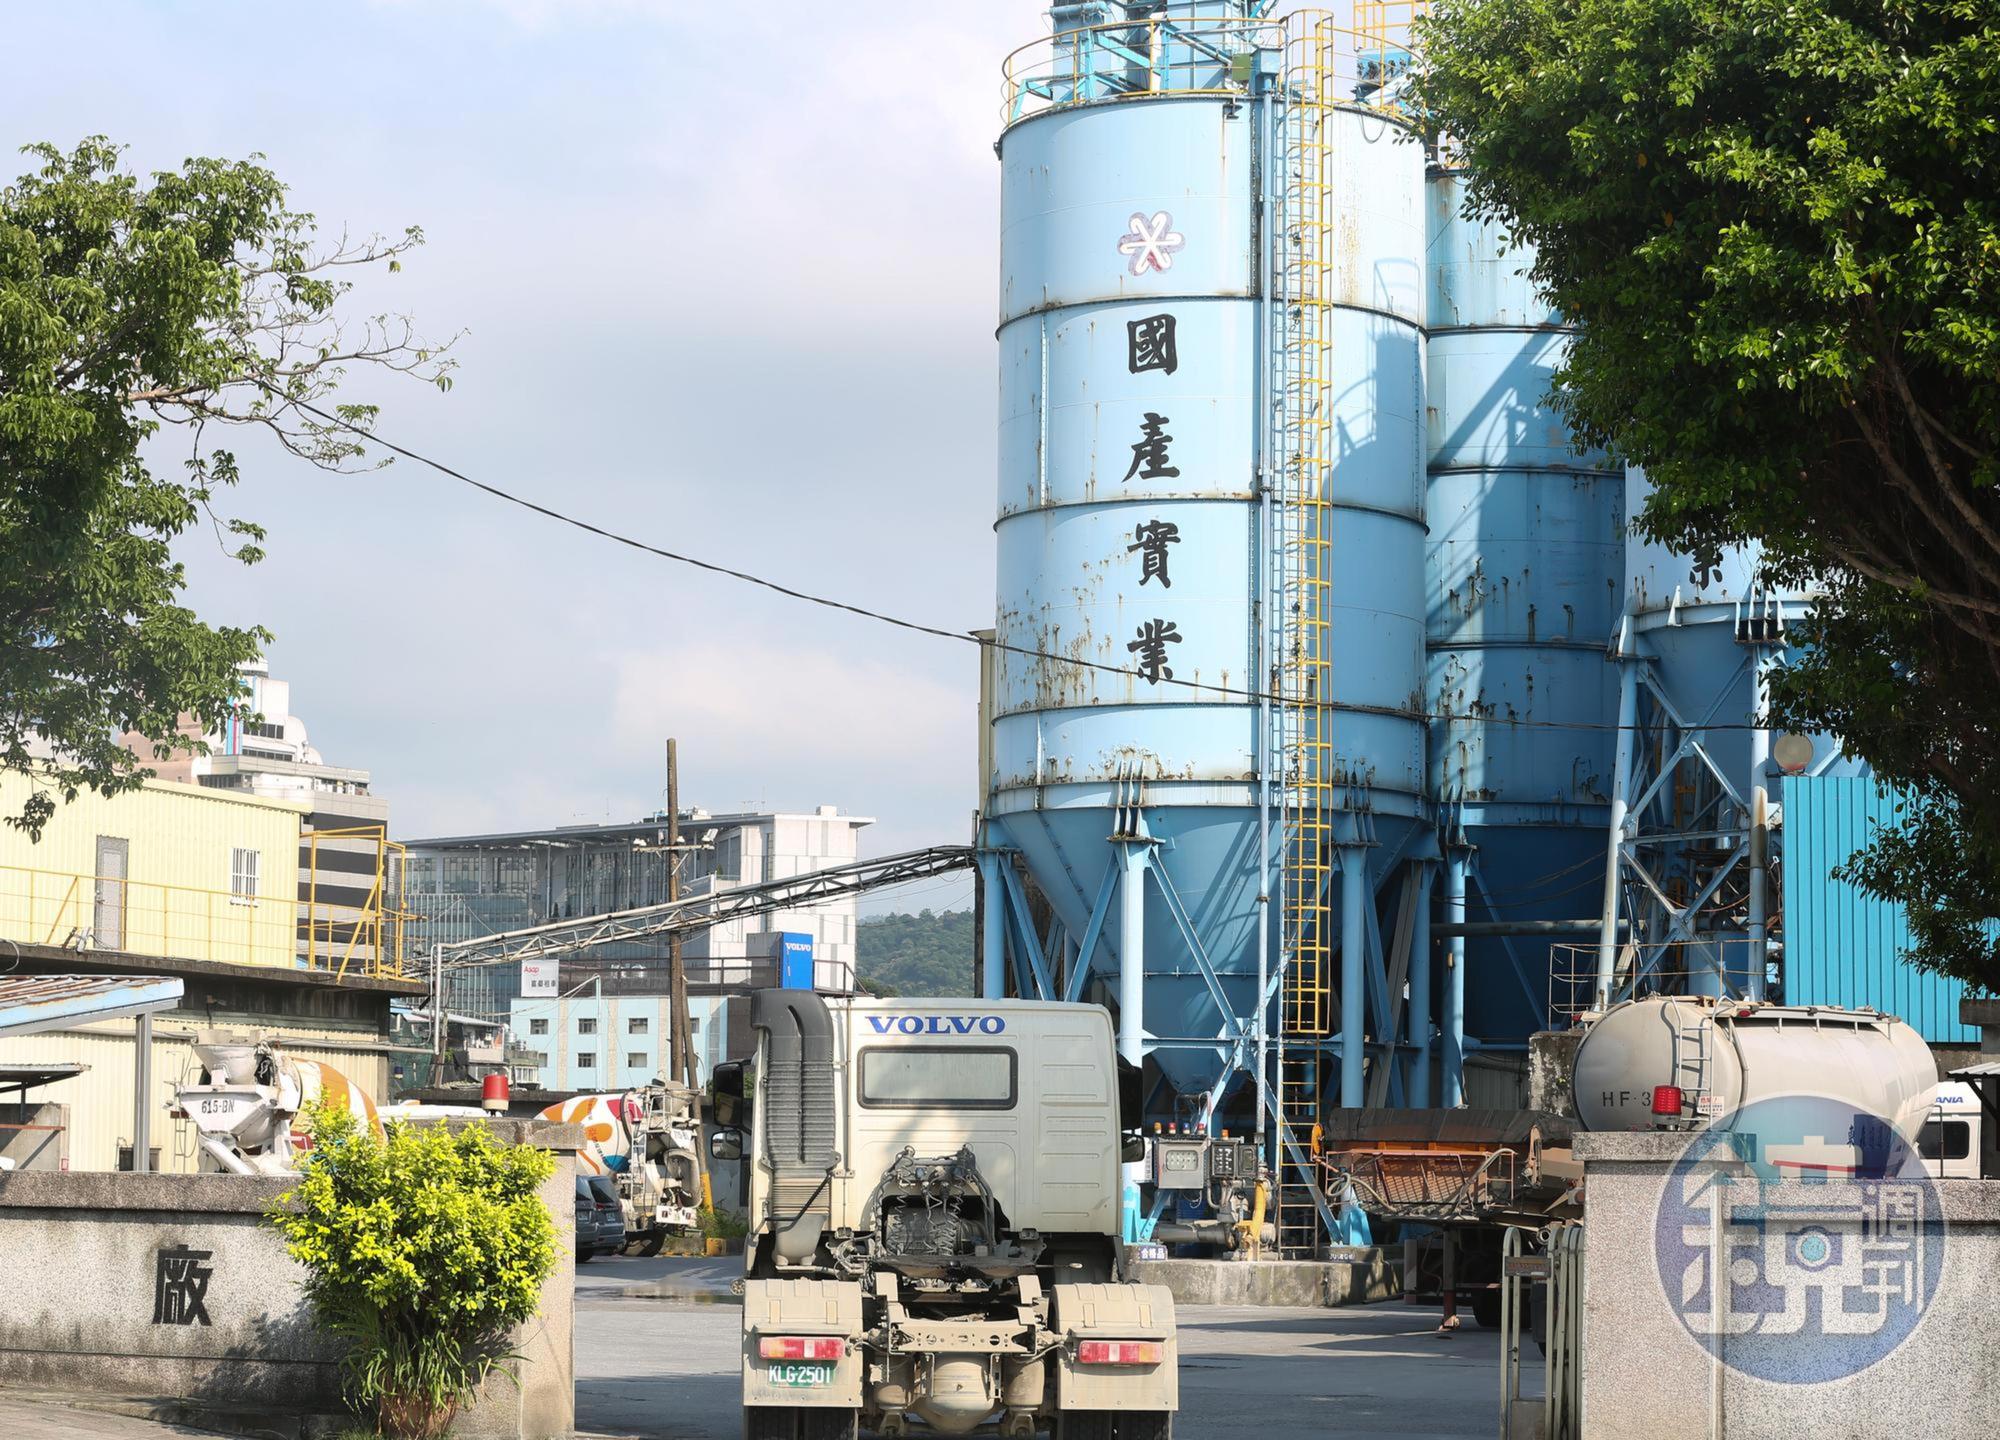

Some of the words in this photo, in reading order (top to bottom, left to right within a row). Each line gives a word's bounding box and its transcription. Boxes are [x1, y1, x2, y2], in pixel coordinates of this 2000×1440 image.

[1122, 313, 1183, 686] 國產實業
[785, 942, 811, 952] VOLVO
[864, 1016, 1006, 1034] VOLVO
[201, 1099, 235, 1114] 615-BN
[1935, 1096, 1964, 1104] ANIA
[151, 1244, 214, 1327] 廠
[768, 1365, 831, 1384] KLG-2501
